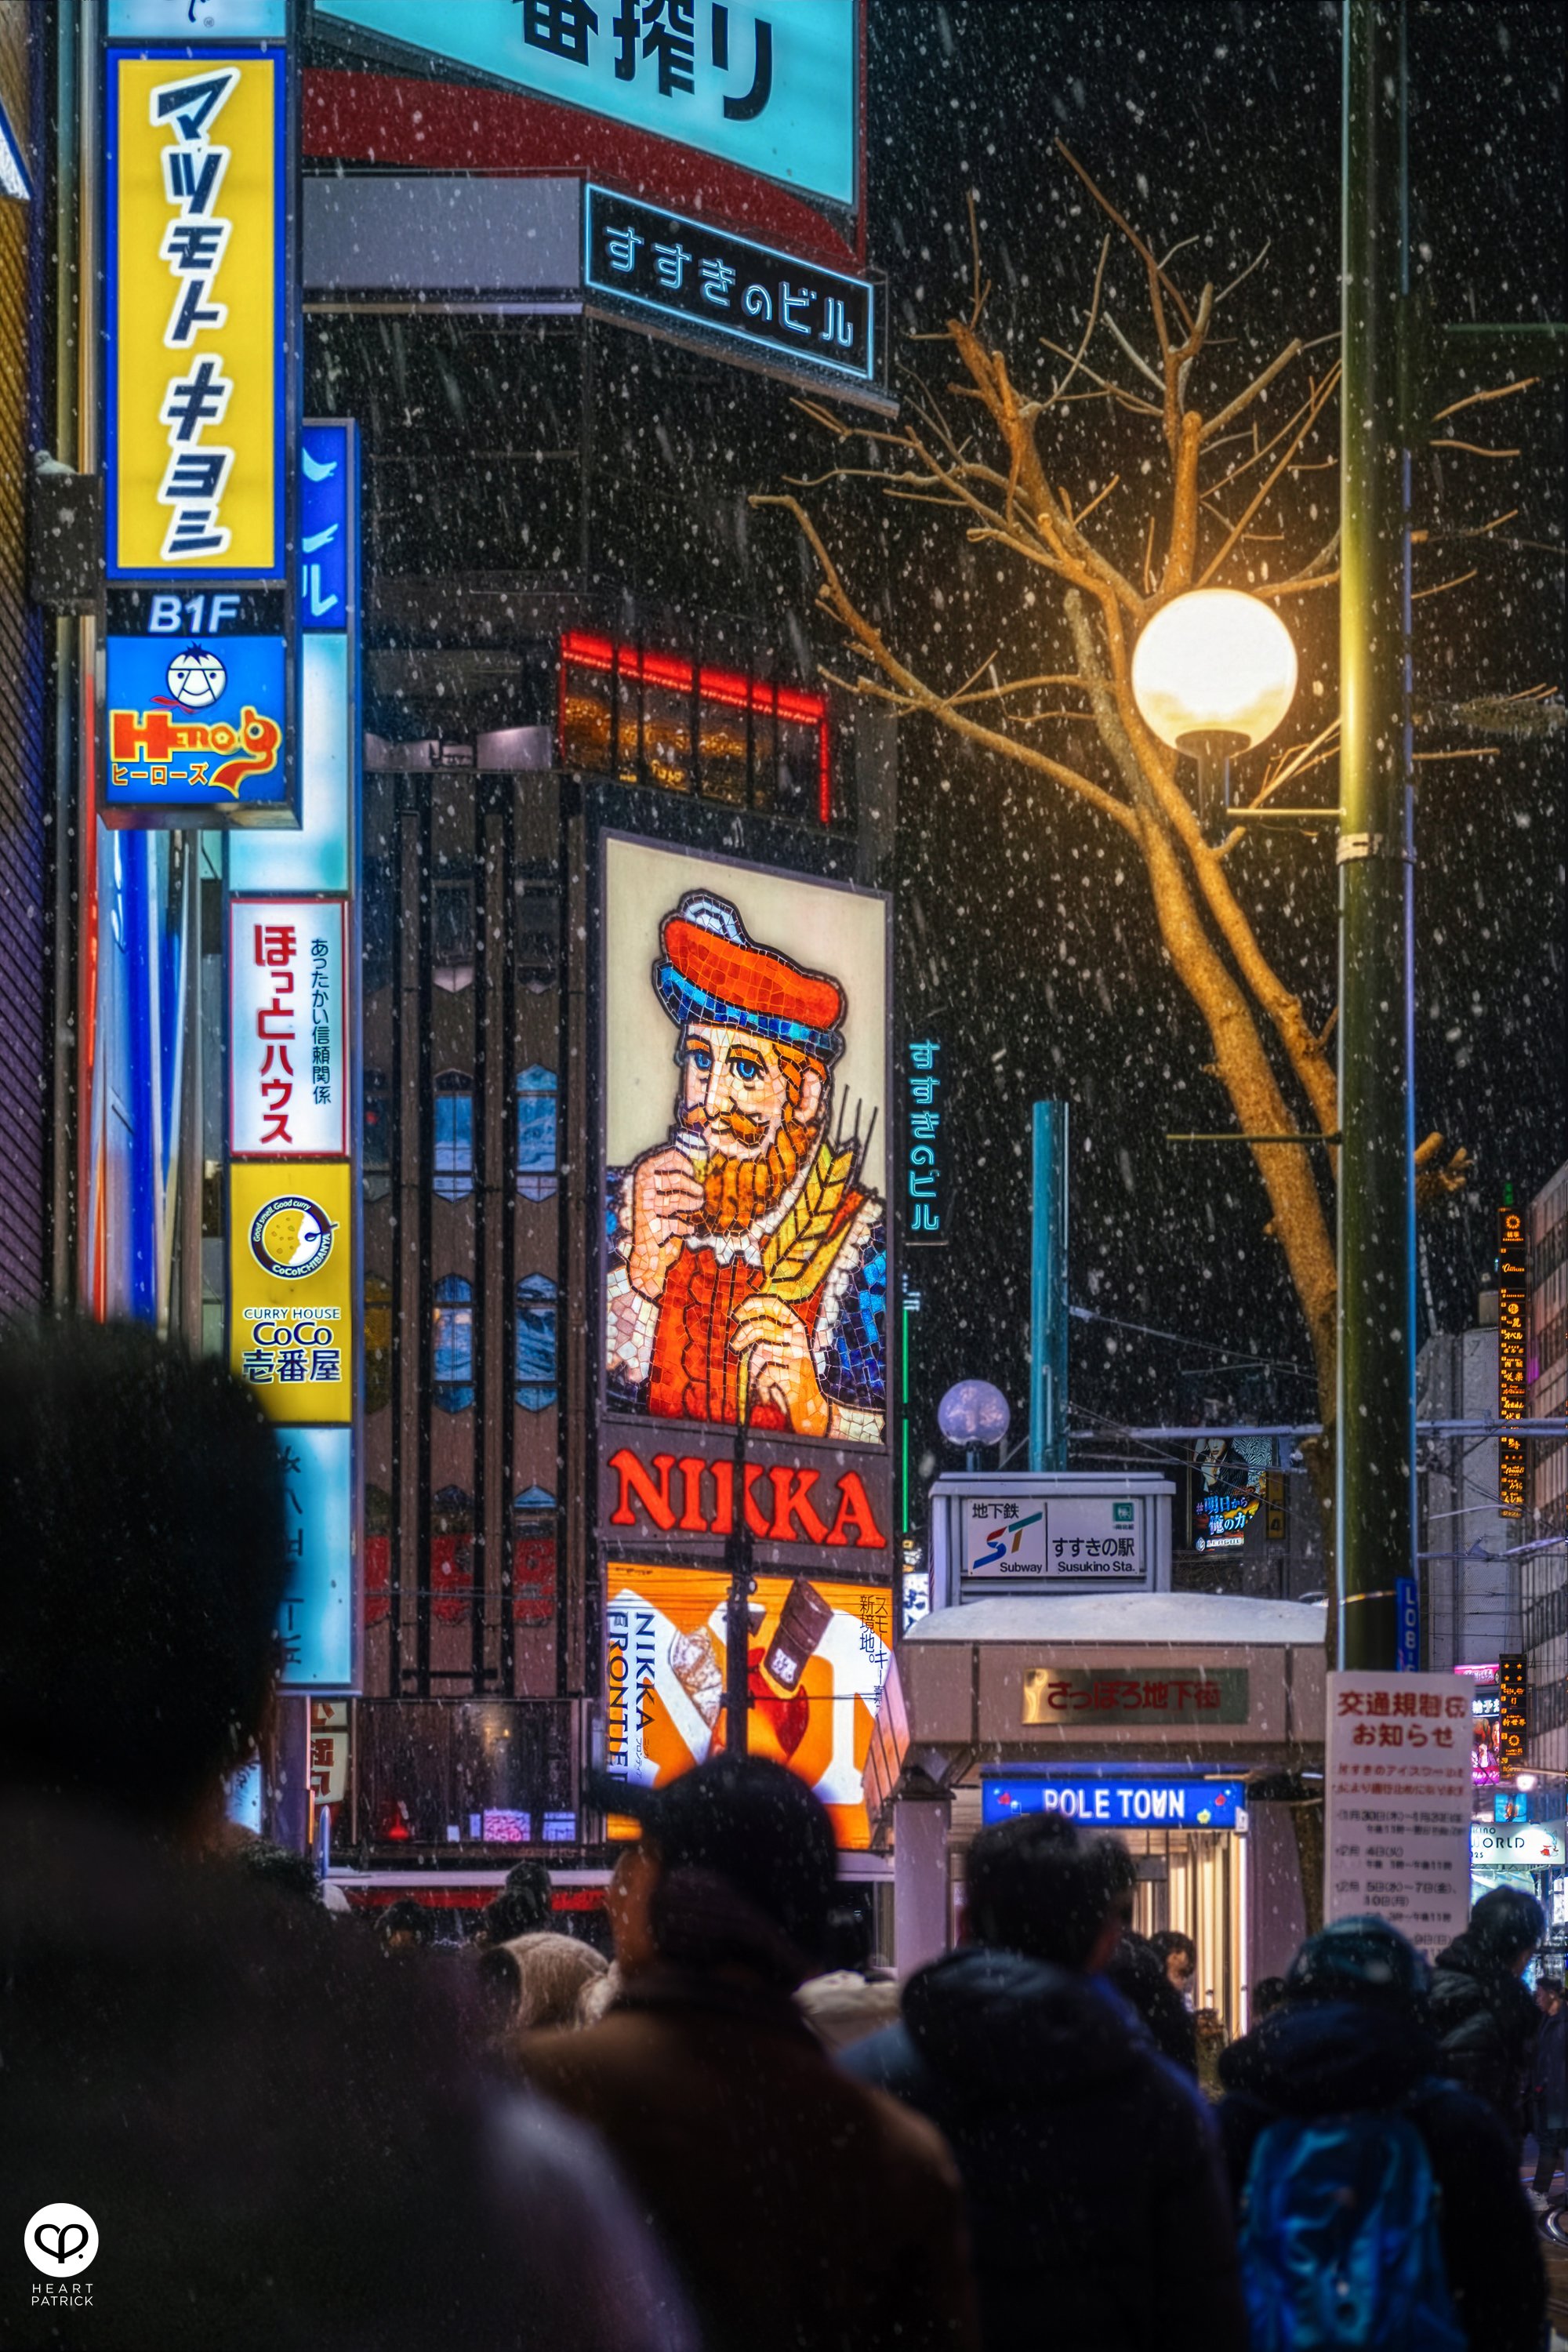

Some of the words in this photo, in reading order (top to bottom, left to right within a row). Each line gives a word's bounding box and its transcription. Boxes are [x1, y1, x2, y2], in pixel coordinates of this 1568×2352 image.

[604, 226, 854, 347] すすきのビル
[151, 69, 240, 559] マツモトキヨシ
[148, 594, 240, 633] B1F
[112, 762, 209, 786] ヒーローズ
[254, 924, 297, 1145] ほっとハウス
[310, 939, 332, 1105] あったかい信頼関係
[909, 1040, 940, 1230] すすきのビル
[253, 1222, 263, 1242] Good
[274, 1199, 293, 1210] Good
[293, 1200, 311, 1210] curry
[244, 1308, 289, 1319] CURRY
[292, 1308, 340, 1319] HOUSE
[252, 1320, 333, 1346] CoCo
[242, 1348, 341, 1383] 壱番屋
[608, 1449, 887, 1548] NIKKA
[972, 1503, 1019, 1519] 地下鉄
[1052, 1537, 1135, 1557] すすきの駅
[1000, 1562, 1043, 1574] Subway
[1058, 1561, 1110, 1573] Susukino
[1112, 1561, 1135, 1573] Sta.
[859, 1595, 876, 1664] 新境地。
[636, 1612, 655, 1732] NIKKA
[1047, 1680, 1221, 1710] さっぽろ地下街
[1353, 1722, 1454, 1748] お知らせ
[1044, 1788, 1112, 1818] POLE
[1116, 1788, 1185, 1819] TOWN
